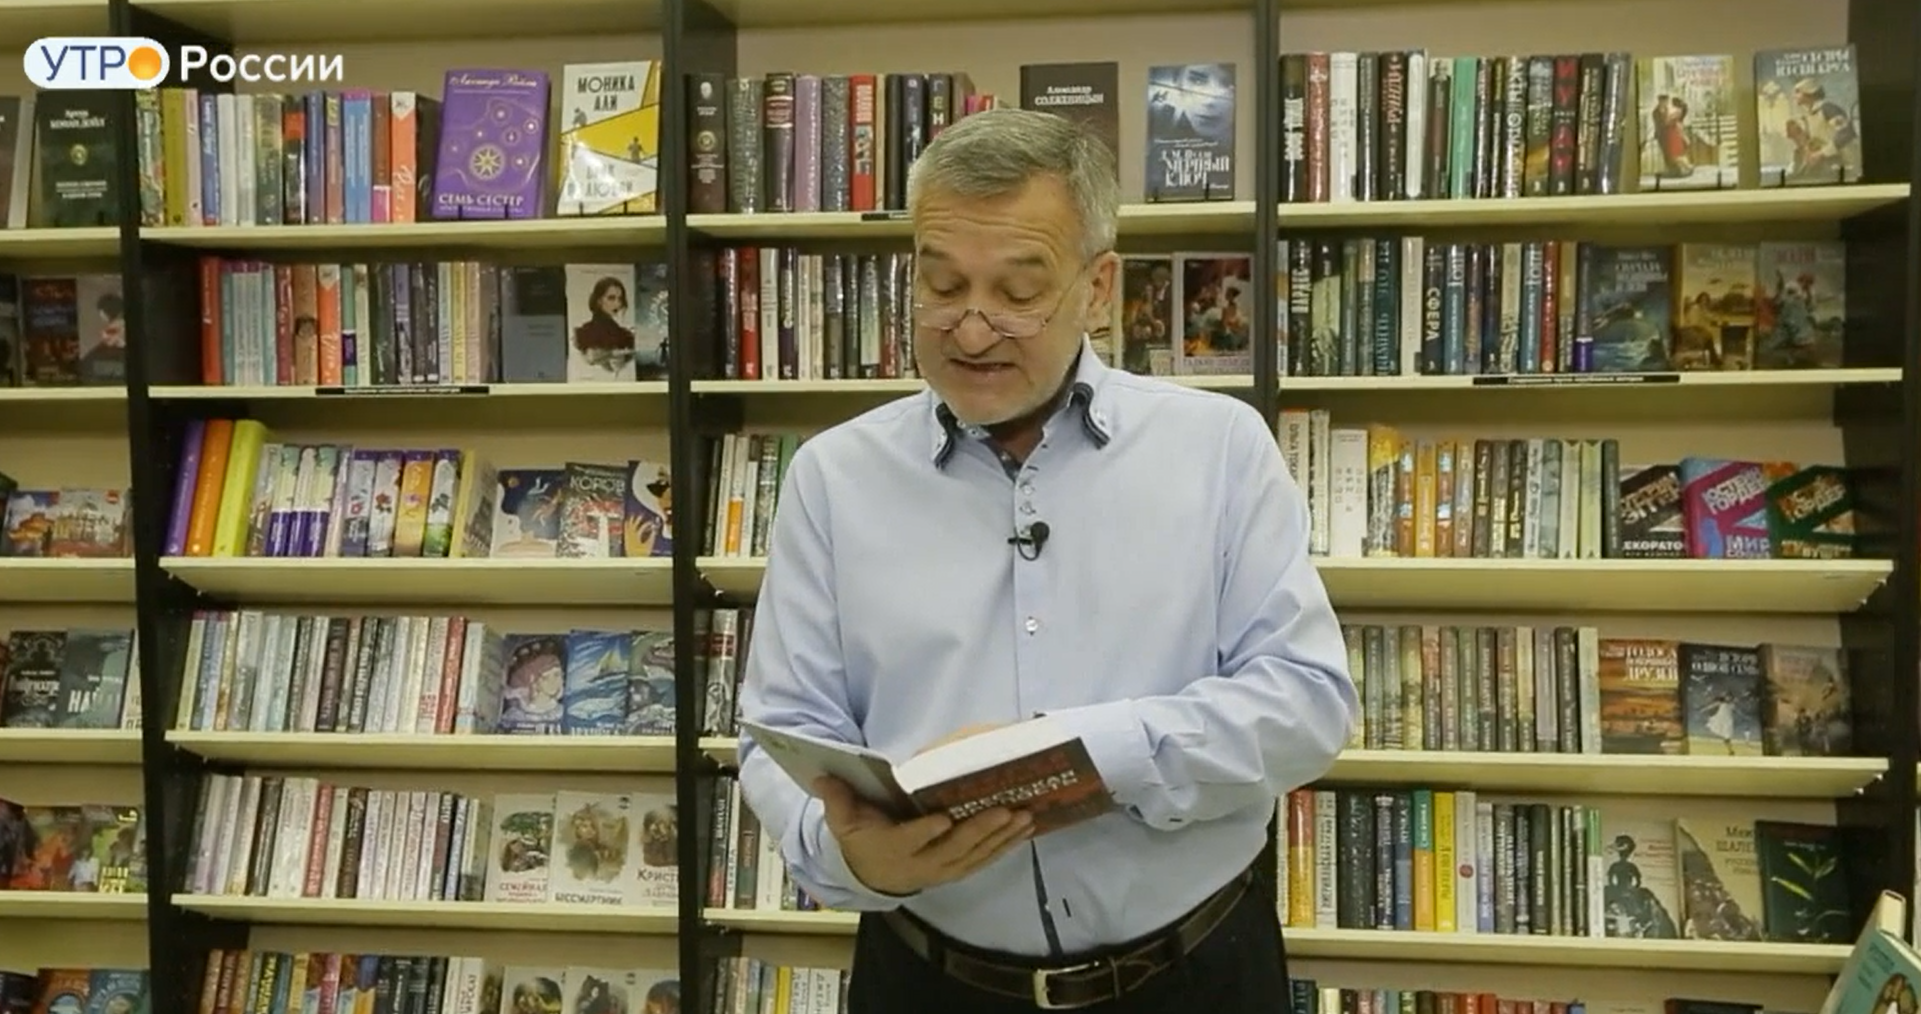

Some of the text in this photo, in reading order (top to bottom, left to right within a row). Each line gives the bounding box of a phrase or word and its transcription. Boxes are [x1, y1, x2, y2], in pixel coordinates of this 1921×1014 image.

[577, 75, 636, 94] МОНИКА
[1426, 286, 1441, 341] СФЕРА
[1621, 540, 1685, 551] ЕКОРАТО
